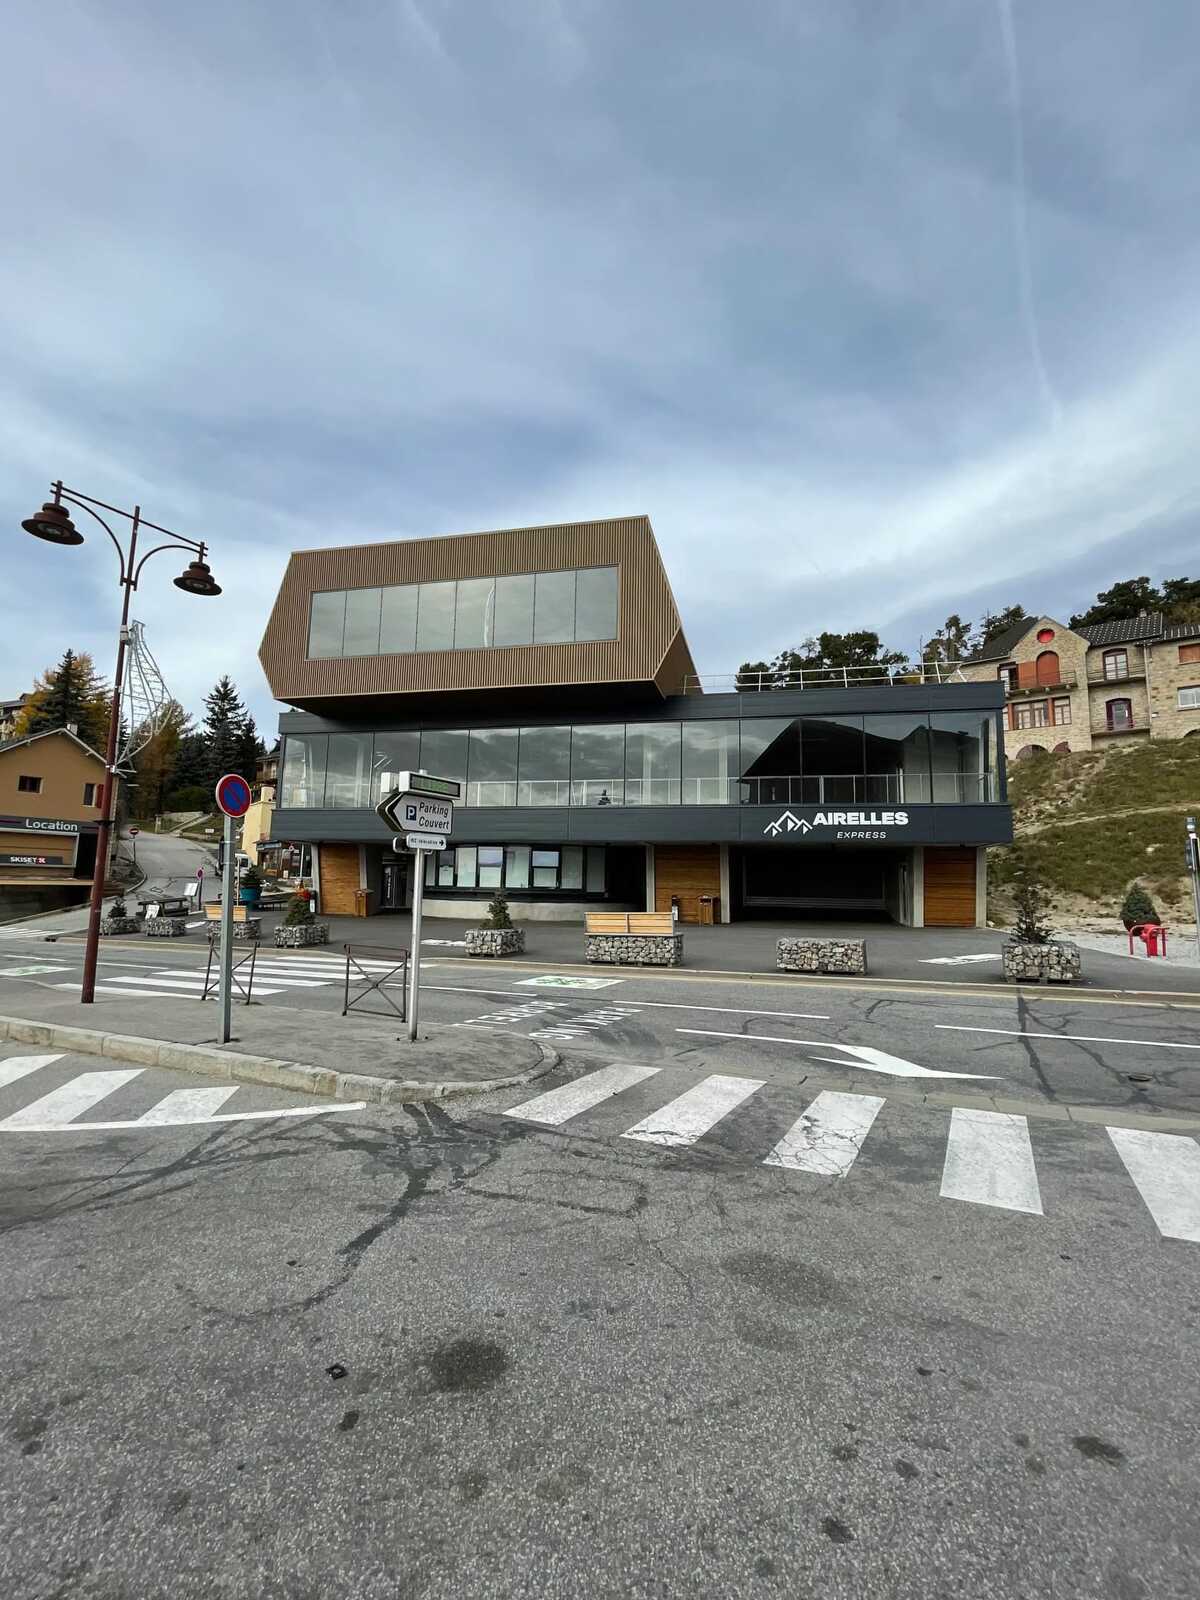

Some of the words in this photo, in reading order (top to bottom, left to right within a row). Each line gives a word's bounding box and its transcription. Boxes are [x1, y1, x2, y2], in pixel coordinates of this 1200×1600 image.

[419, 802, 449, 818] Parking
[26, 819, 78, 831] Location
[418, 816, 450, 830] Couvert
[813, 811, 909, 826] AIRELLES
[836, 831, 887, 839] EXPRESS
[528, 1006, 643, 1040] PARKING
